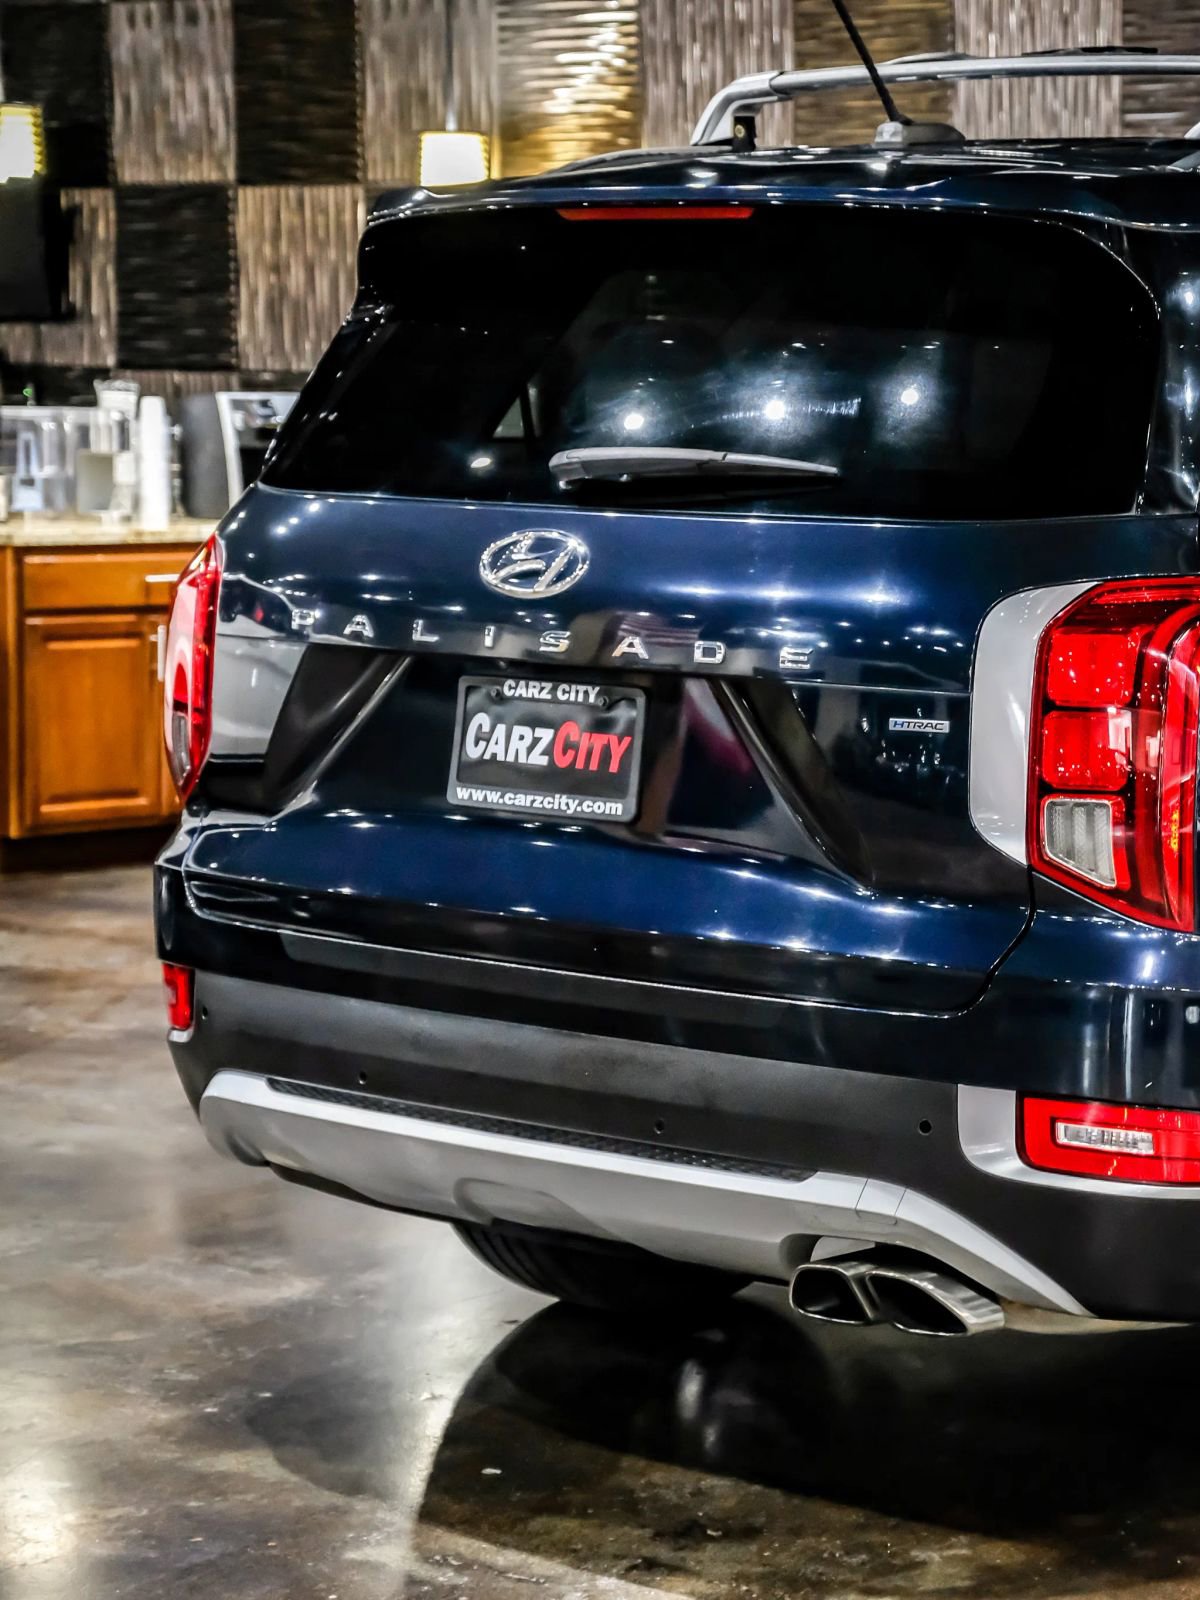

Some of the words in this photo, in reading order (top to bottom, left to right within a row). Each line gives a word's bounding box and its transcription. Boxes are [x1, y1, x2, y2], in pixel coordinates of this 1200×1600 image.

[291, 608, 812, 670] PALISADE
[503, 679, 553, 699] CARZ
[556, 683, 600, 704] CITY
[892, 720, 945, 731] HTRAC
[456, 786, 623, 816] www.carzcity.com
